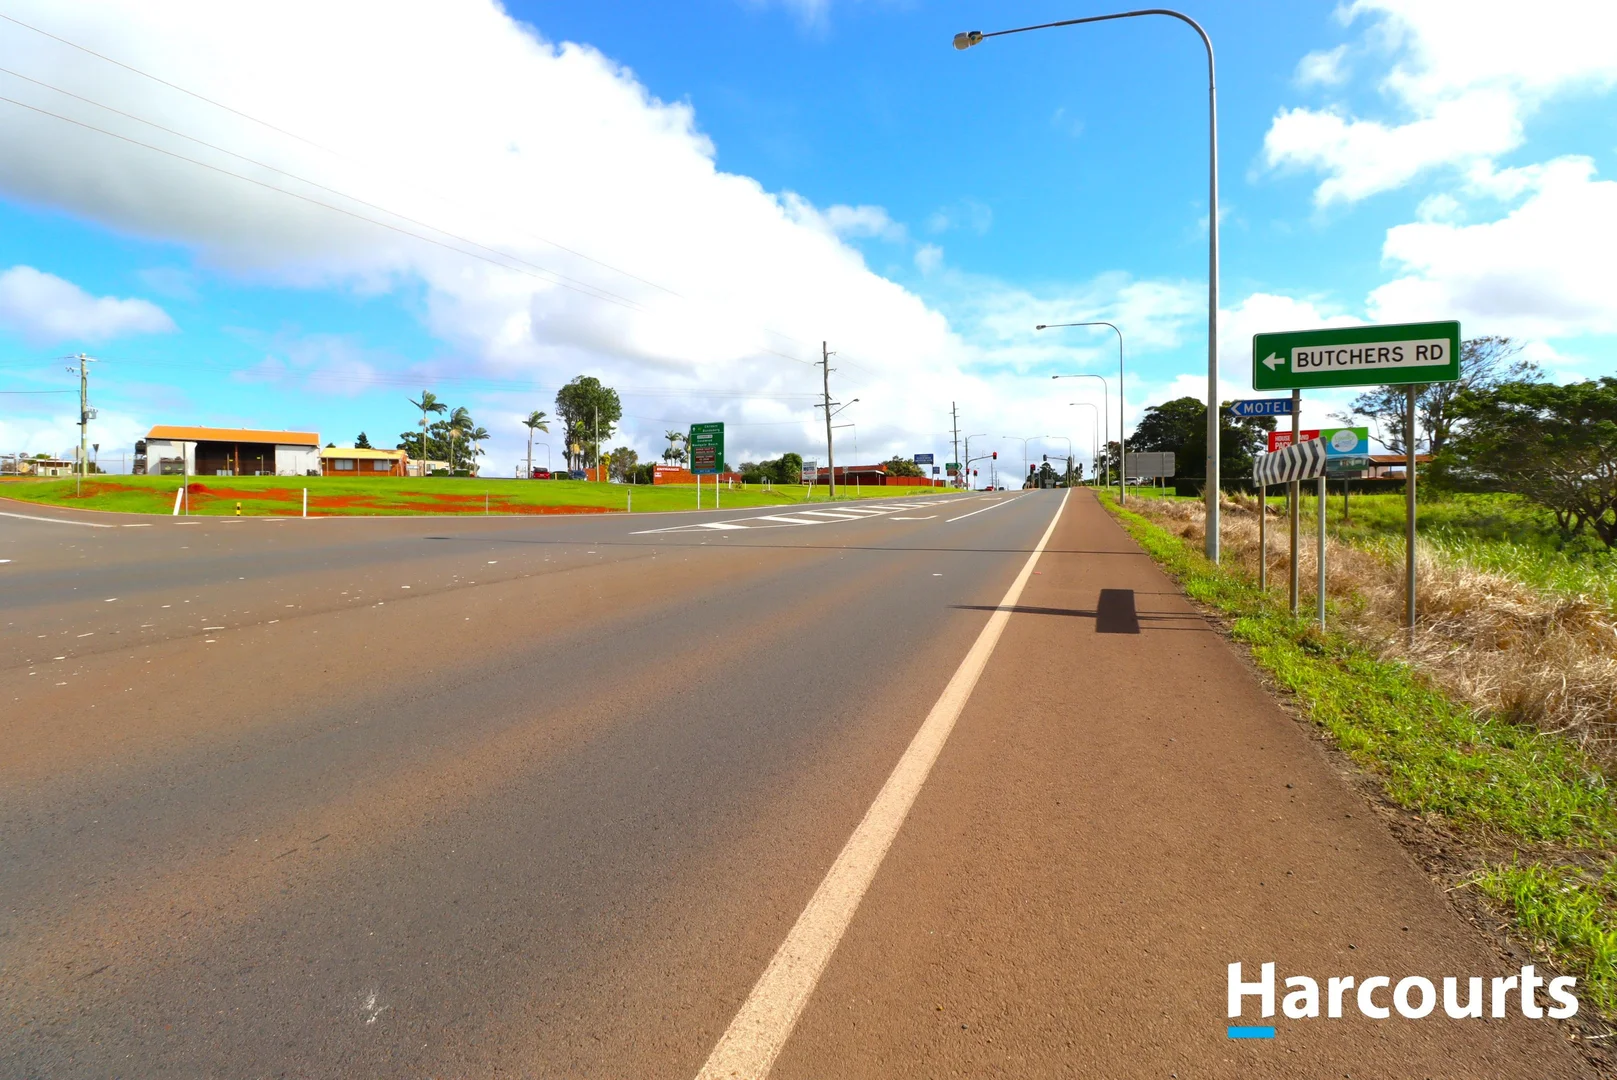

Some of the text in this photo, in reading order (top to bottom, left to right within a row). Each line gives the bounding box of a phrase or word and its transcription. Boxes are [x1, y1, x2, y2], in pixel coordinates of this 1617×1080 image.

[1297, 344, 1444, 368] BUTCHERS RD
[1244, 402, 1290, 414] MOTEL
